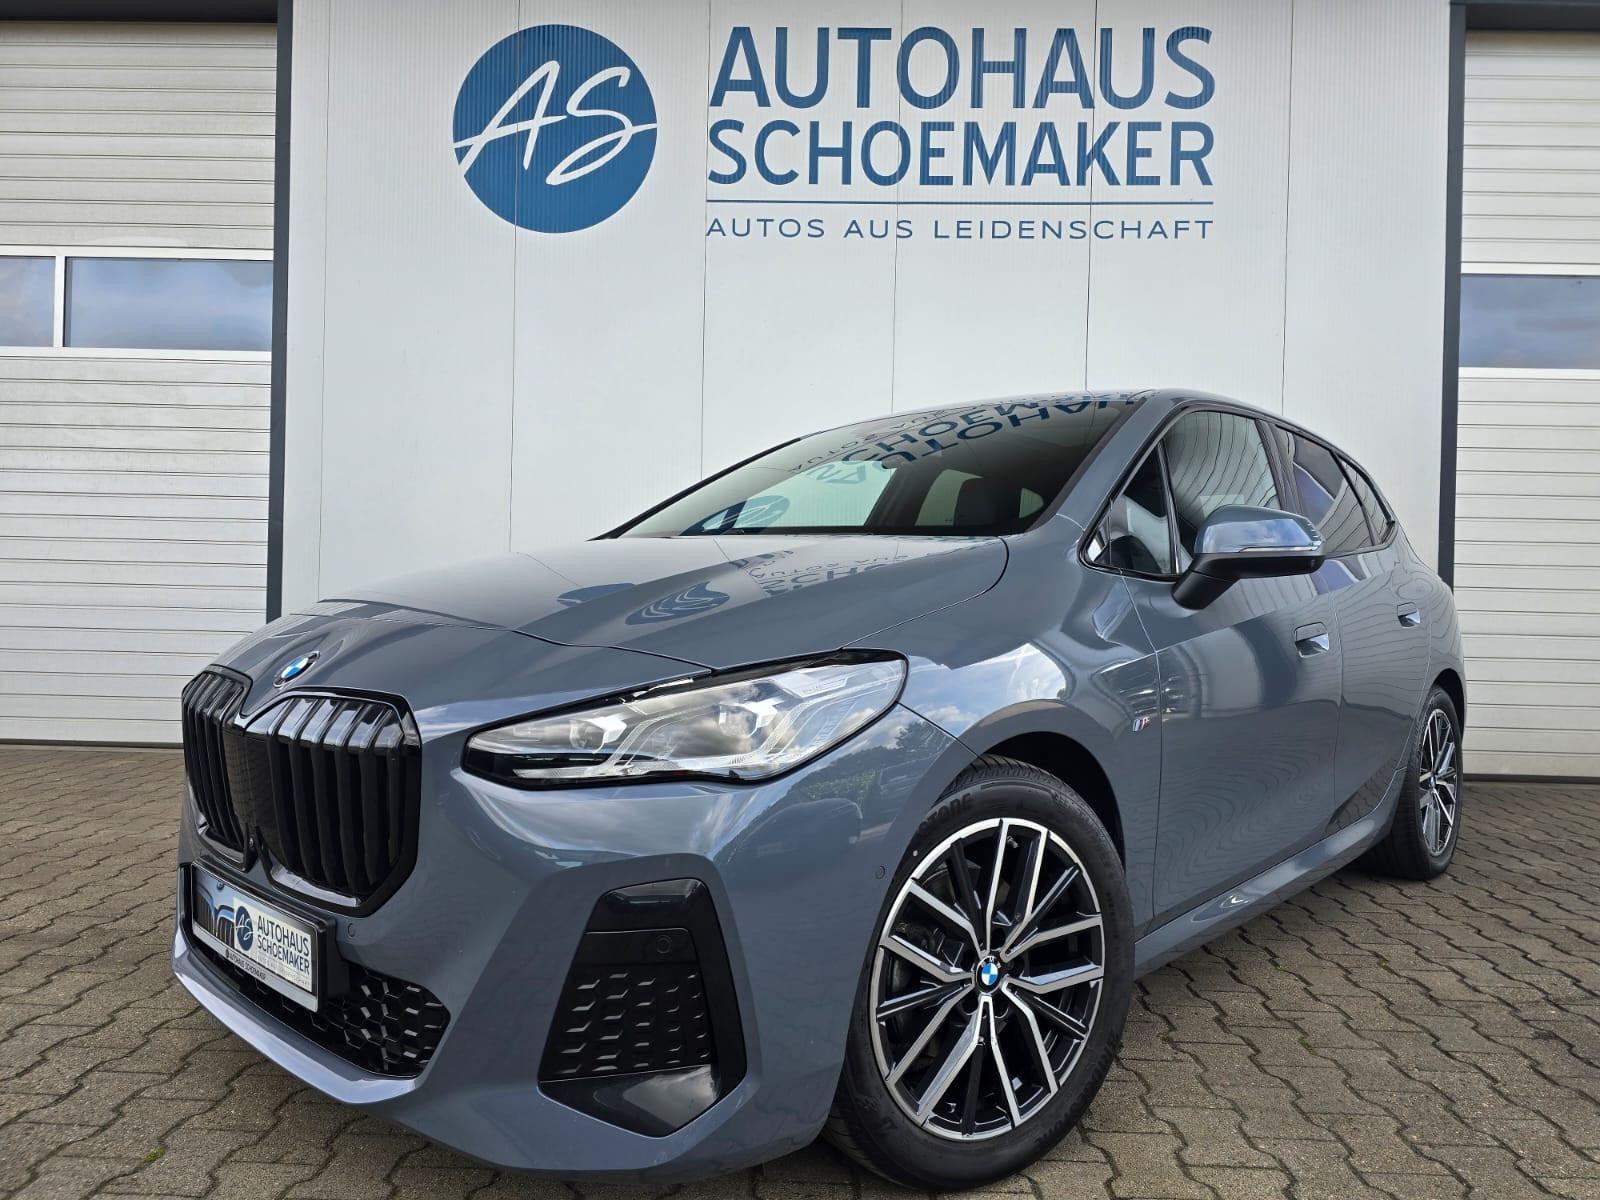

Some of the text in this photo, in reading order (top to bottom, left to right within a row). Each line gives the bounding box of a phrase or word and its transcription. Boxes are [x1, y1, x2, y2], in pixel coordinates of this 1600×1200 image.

[709, 26, 1215, 109] AUTOHAUS
[453, 60, 657, 186] AS
[708, 119, 1214, 187] SCHOEMAKER
[706, 218, 1213, 240] AUTOS AUS LEIDENSCHAFT
[257, 915, 310, 957] AUTOHAUS
[257, 934, 310, 976] SCHOEMAKER
